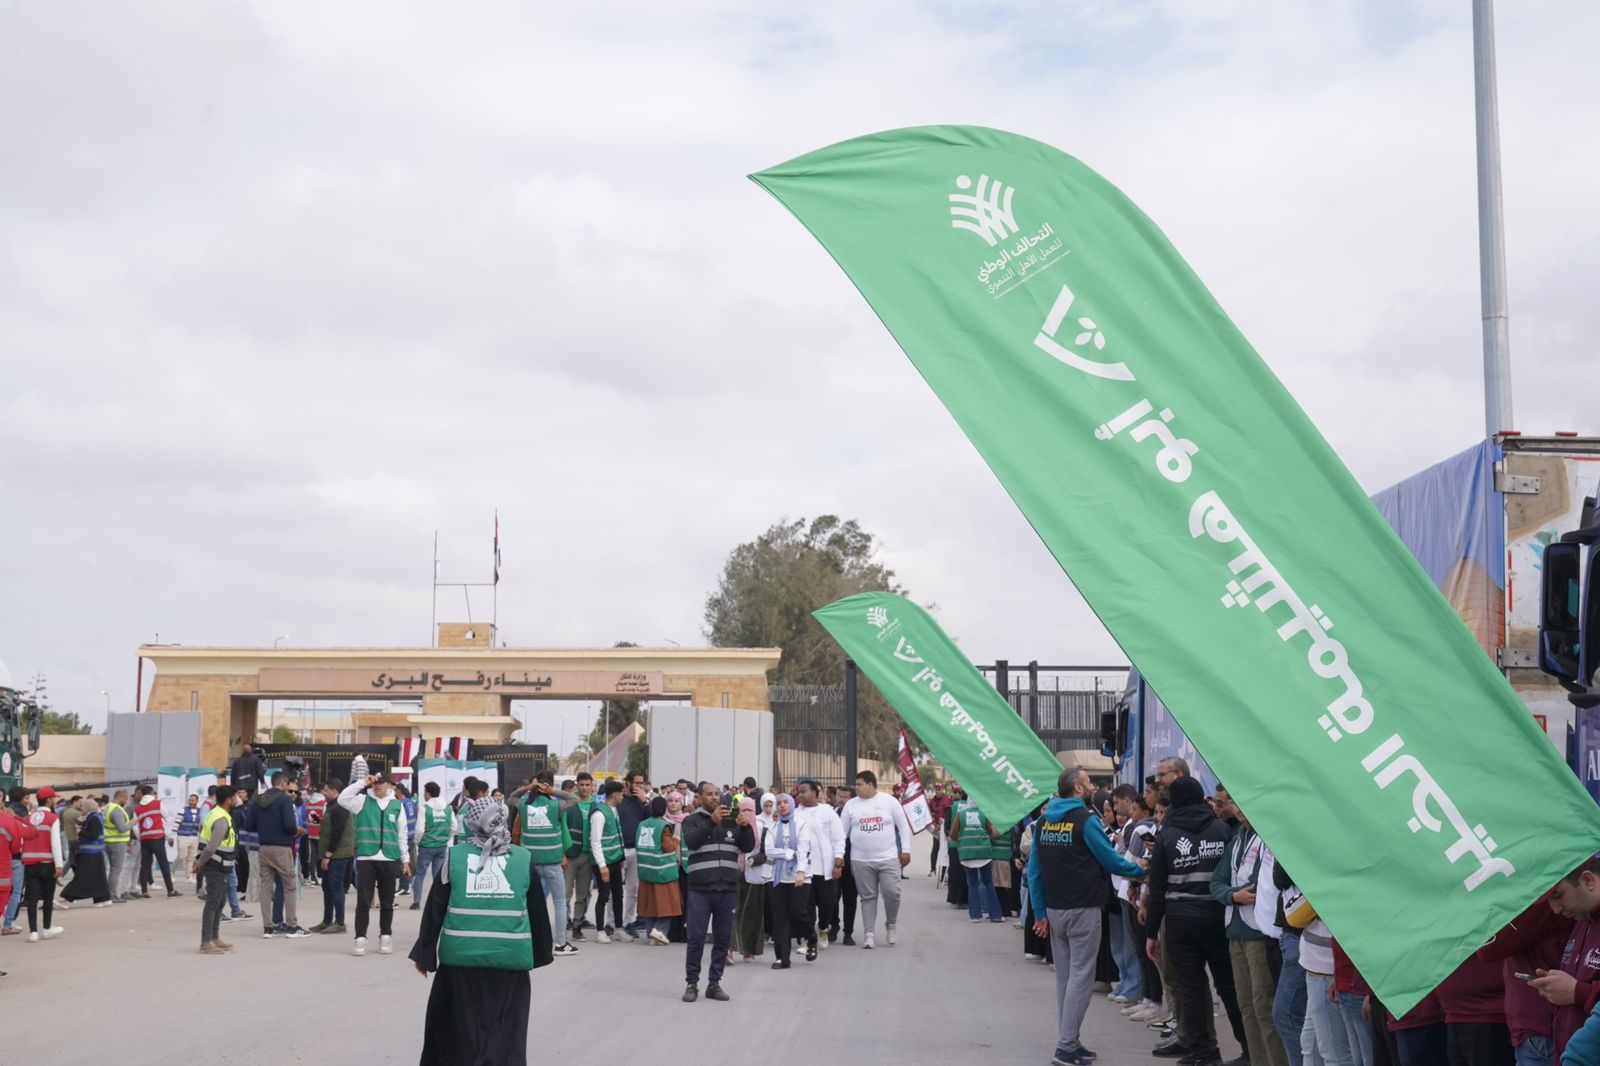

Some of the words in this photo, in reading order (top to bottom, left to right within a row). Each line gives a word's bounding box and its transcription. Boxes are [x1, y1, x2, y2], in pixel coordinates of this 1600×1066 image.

[1011, 222, 1054, 257] التحالف
[977, 249, 1011, 284] الوطني
[1094, 398, 1200, 483] أبو
[1188, 489, 1375, 743] هشيمة
[1360, 732, 1516, 893] الخير
[431, 671, 492, 690] رفح
[493, 671, 553, 691] ميناء
[1040, 829, 1073, 843] Mersal
